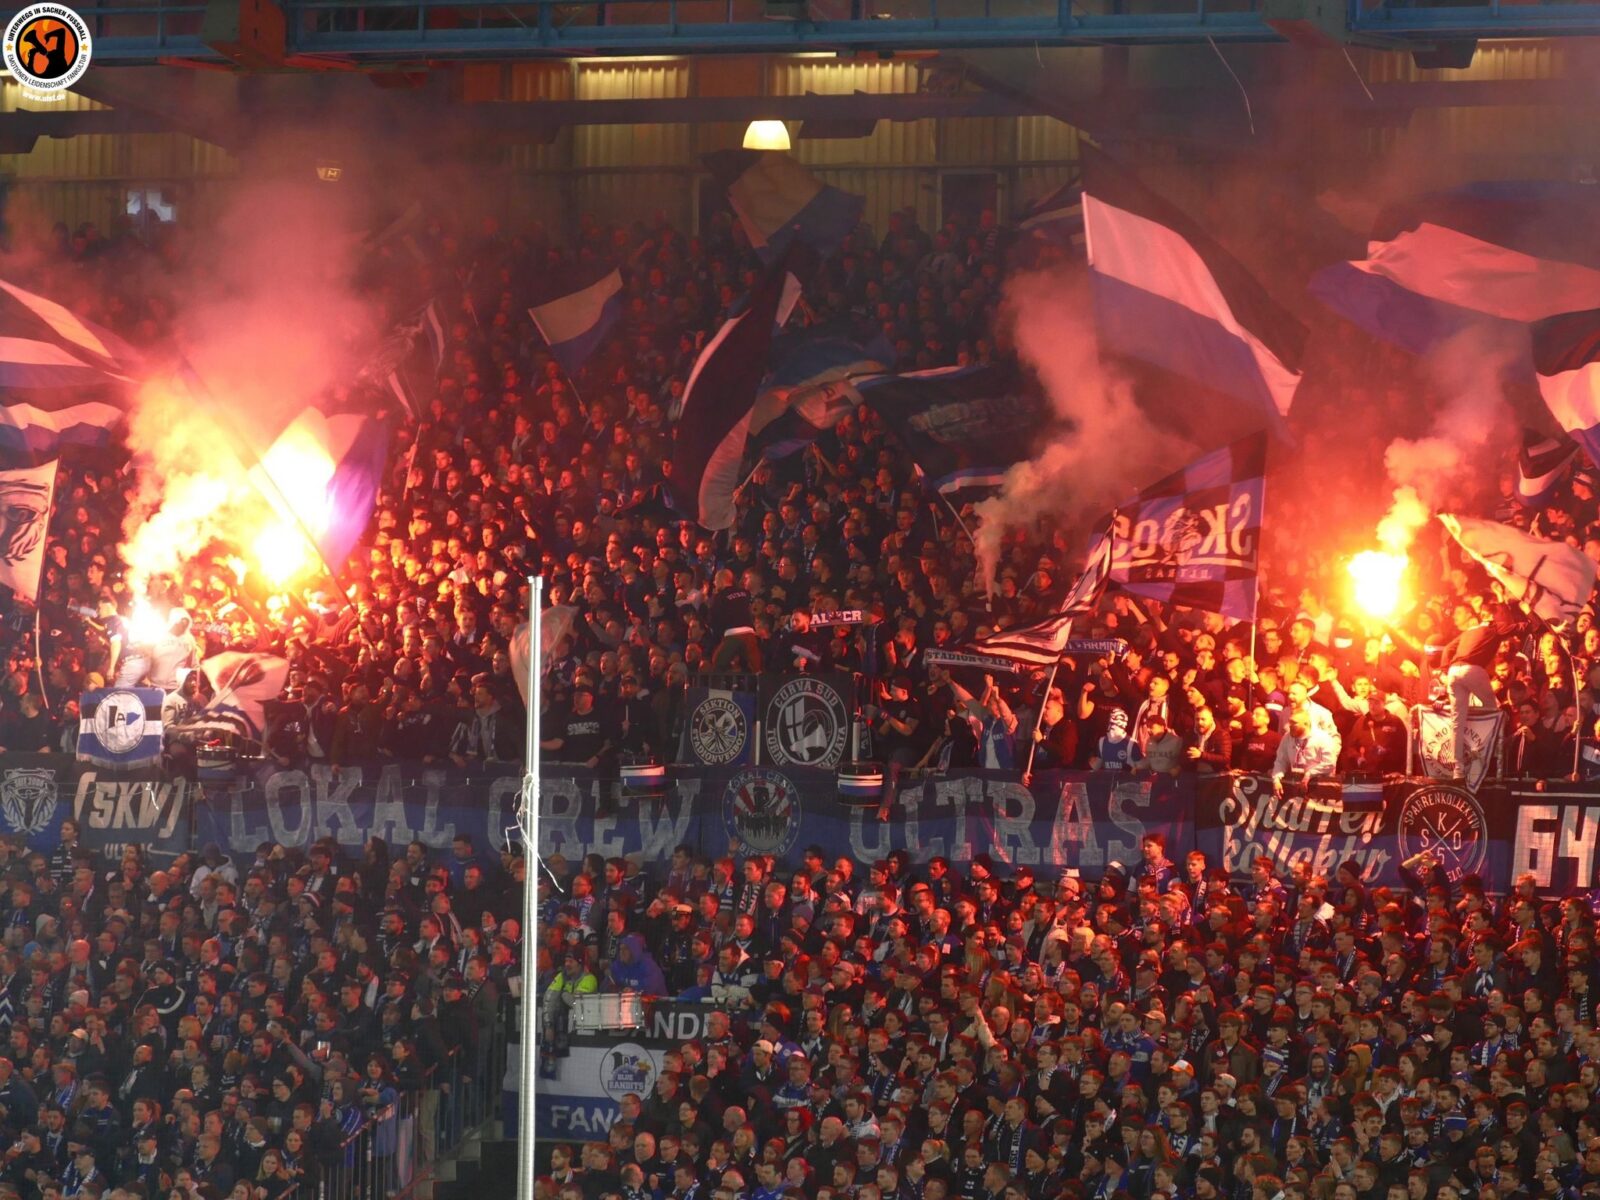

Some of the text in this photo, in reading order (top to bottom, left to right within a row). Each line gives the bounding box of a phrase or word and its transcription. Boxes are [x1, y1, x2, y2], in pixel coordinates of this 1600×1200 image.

[774, 680, 839, 707] CURVA SUD
[700, 699, 741, 718] SEKTION
[692, 729, 745, 763] STADIONVERBOT
[229, 763, 1152, 866] LOKAL CREW ULTRAS
[1404, 792, 1481, 829] SPARRENKOLLEKTIV
[1438, 811, 1448, 831] K
[1420, 828, 1430, 848] S
[1512, 804, 1600, 888] 64
[609, 1081, 644, 1089] BANDITS
[617, 1073, 634, 1081] BLUE
